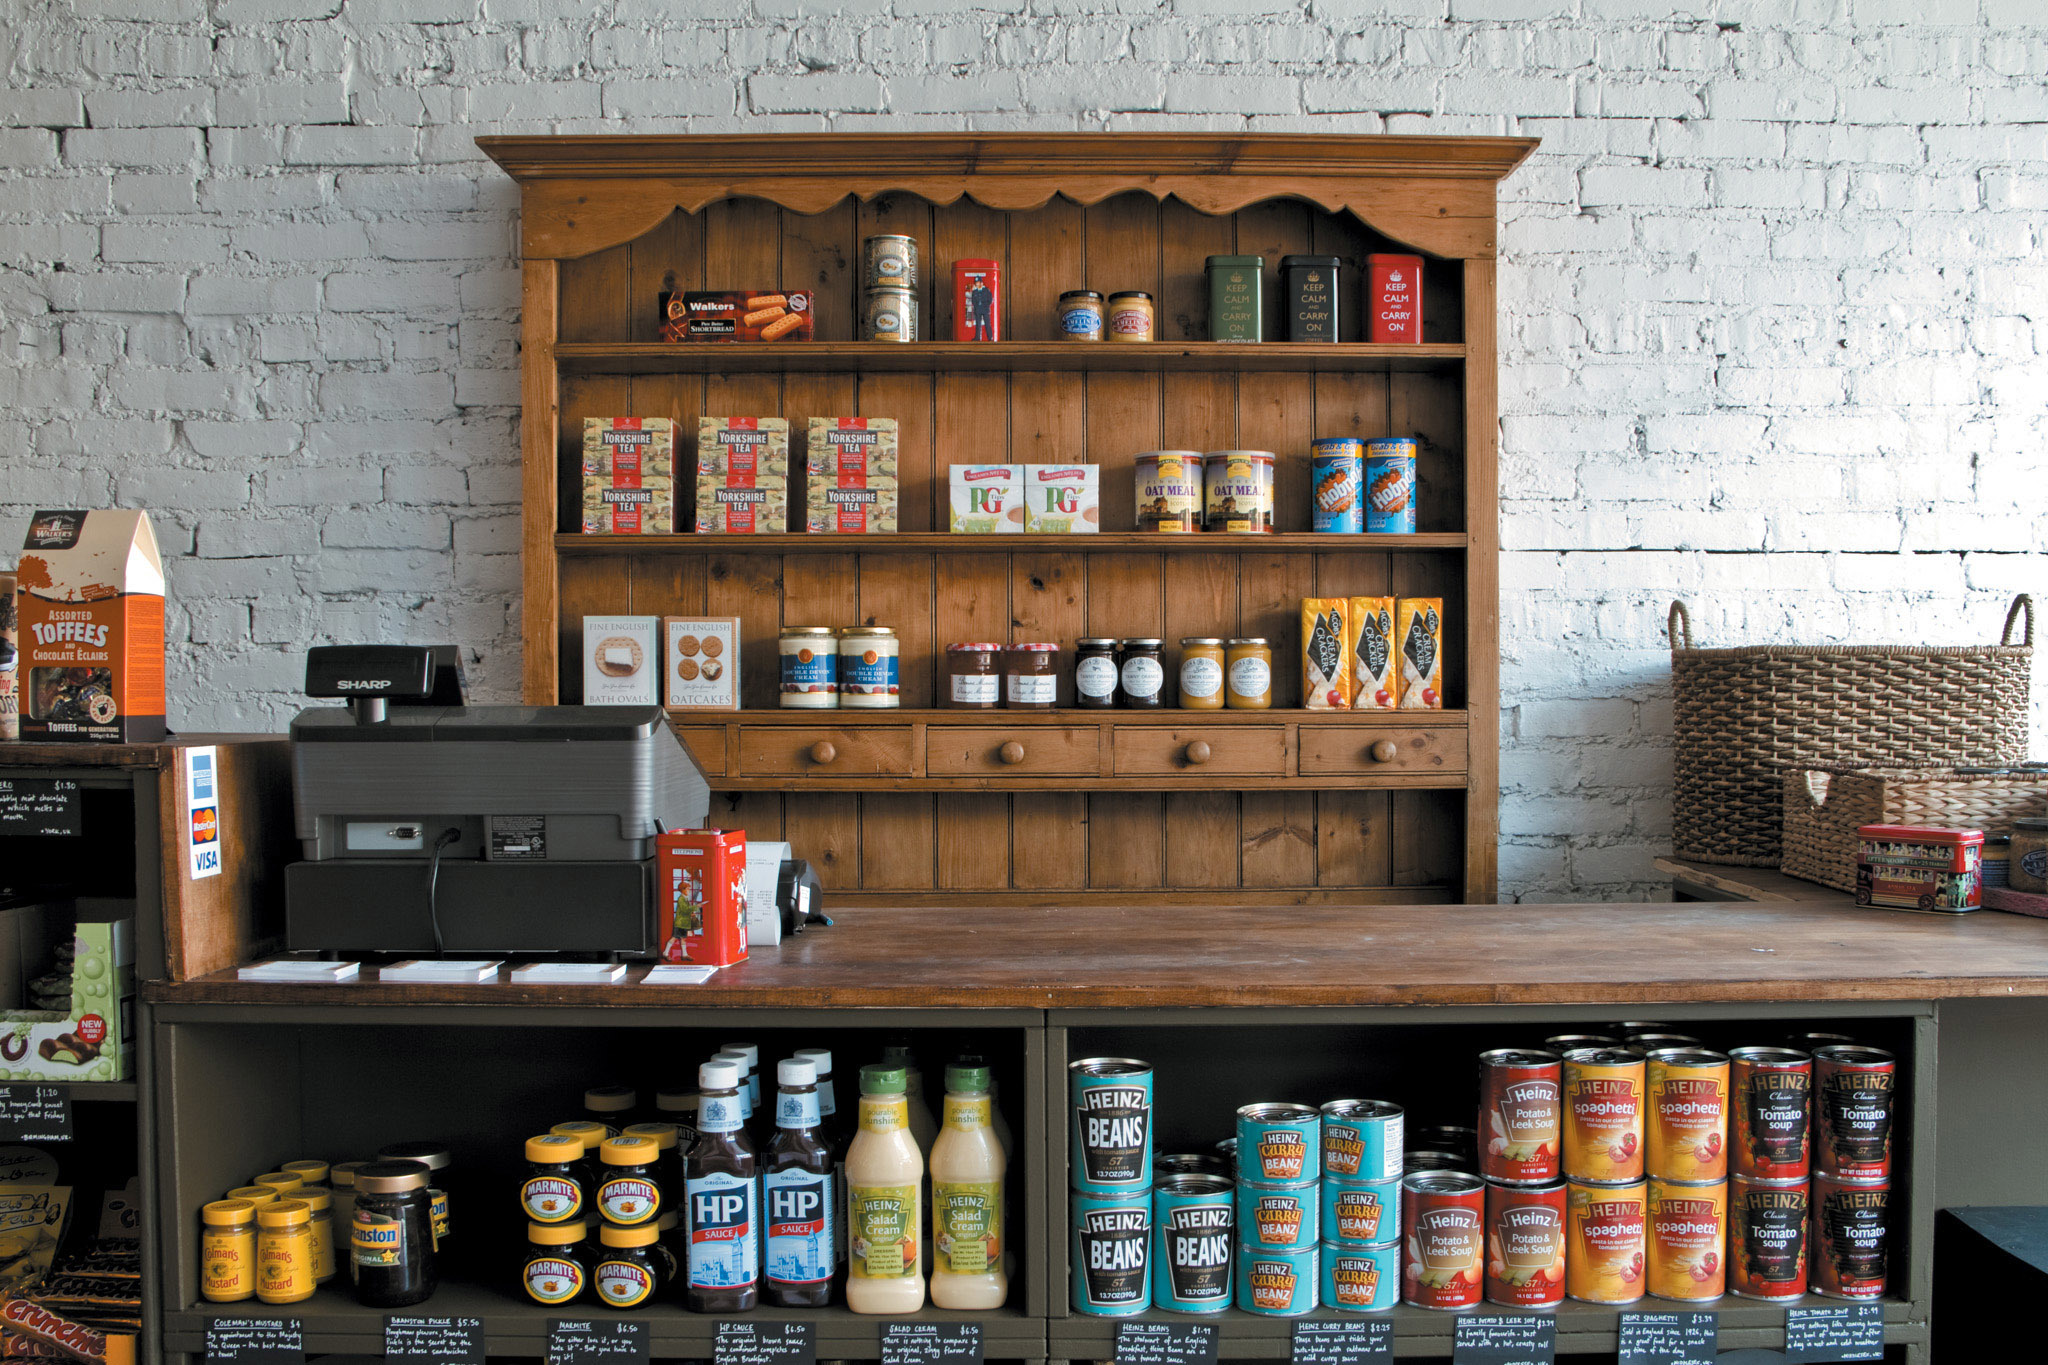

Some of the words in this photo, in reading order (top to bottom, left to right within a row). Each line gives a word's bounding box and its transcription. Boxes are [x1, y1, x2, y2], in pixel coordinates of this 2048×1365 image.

[1304, 284, 1324, 292] KEEP
[1386, 283, 1406, 291] KEEP
[1302, 295, 1327, 303] CALM
[1383, 295, 1409, 303] CALM
[690, 302, 735, 310] Walkers
[1299, 312, 1328, 320] CARRY
[1381, 312, 1410, 320] CARRY
[1306, 324, 1322, 332] ON
[1388, 323, 1404, 331] ON
[604, 434, 651, 444] YORKSHIRE
[719, 434, 766, 444] YORKSHIRE
[829, 433, 876, 443] YORKSHIRE
[619, 445, 635, 453] TEA
[734, 445, 750, 453] TEA
[844, 444, 860, 452] TEA
[1145, 486, 1164, 496] OAT
[1167, 486, 1195, 496] MEAL
[1214, 486, 1233, 496] OAT
[717, 492, 765, 502] YORKSHIRE
[969, 487, 1002, 513] PG
[1045, 487, 1078, 513] PG
[733, 503, 748, 511] TEA
[49, 610, 92, 620] ASSORTED
[32, 622, 109, 647] TOFFEES
[1316, 627, 1329, 673] CRACKERS
[1326, 635, 1337, 666] CREAM
[1365, 627, 1378, 672] CRACKERS
[1375, 635, 1385, 665] CREAM
[1412, 625, 1424, 671] CRACKERS
[1422, 634, 1431, 664] CREAM
[33, 649, 74, 660] CHOCOLATE
[337, 680, 391, 690] SHARP
[671, 695, 731, 704] OATCAKES
[48, 722, 77, 732] TOFFEES
[195, 850, 218, 871] VISA
[82, 1020, 102, 1028] NEW
[1581, 1082, 1630, 1095] HEINZ
[1668, 1082, 1716, 1095] HEINZ
[1755, 1075, 1805, 1091] HEINZ
[1839, 1075, 1889, 1091] HEINZ
[1515, 1086, 1553, 1103] Heinz
[1769, 1092, 1793, 1100] Classic
[1088, 1092, 1142, 1109] HEINZ
[867, 1108, 897, 1117] pourable
[952, 1106, 982, 1115] pourable
[1516, 1109, 1546, 1119] Potato
[1575, 1102, 1635, 1115] spaghetti
[1660, 1102, 1720, 1115] spaghetti
[1841, 1108, 1886, 1120] Tomato
[1758, 1109, 1802, 1120] Tomato
[865, 1116, 900, 1125] sunshine
[1512, 1119, 1533, 1129] Leek
[1536, 1119, 1555, 1130] Soup
[1769, 1120, 1793, 1131] soup
[1852, 1120, 1876, 1131] soup
[1088, 1117, 1143, 1148] BEANS
[1268, 1134, 1297, 1144] HEINZ
[1265, 1158, 1300, 1169] BEANZ
[528, 1181, 572, 1196] MARMITE
[605, 1182, 651, 1198] MARMITE
[773, 1190, 819, 1219] HP
[949, 1197, 985, 1209] HEINZ
[1264, 1200, 1294, 1210] HEINZ
[1343, 1195, 1373, 1205] HEINZ
[697, 1195, 744, 1223] HP
[865, 1201, 900, 1212] HEINZ
[1593, 1204, 1639, 1217] HEINZ
[868, 1213, 897, 1225] Salad
[952, 1209, 981, 1221] Salad
[1176, 1211, 1228, 1229] HEINZ
[950, 1221, 984, 1231] Cream
[1341, 1218, 1376, 1231] BEANZ
[1430, 1214, 1470, 1230] Heinz
[705, 1229, 733, 1239] SAUCE
[781, 1225, 809, 1234] SAUCE
[866, 1225, 900, 1235] Cream
[1262, 1223, 1297, 1235] BEANZ
[1585, 1222, 1642, 1237] spaghetti
[1432, 1235, 1462, 1245] Potato
[204, 1249, 239, 1261] Colman's
[259, 1249, 292, 1263] Colman's
[1176, 1234, 1228, 1267] BEANS
[1427, 1246, 1450, 1257] Leek
[1453, 1246, 1473, 1258] Soup
[529, 1262, 574, 1277] MARMITE
[600, 1266, 642, 1282] MARMITE
[206, 1277, 239, 1288] Mustard
[261, 1277, 292, 1290] Mustard
[457, 1318, 479, 1327] $5.50
[617, 1323, 638, 1333] $6.50
[889, 1325, 911, 1333] SALAD
[1123, 1324, 1144, 1332] HEINZ
[1148, 1325, 1170, 1333] BEANS
